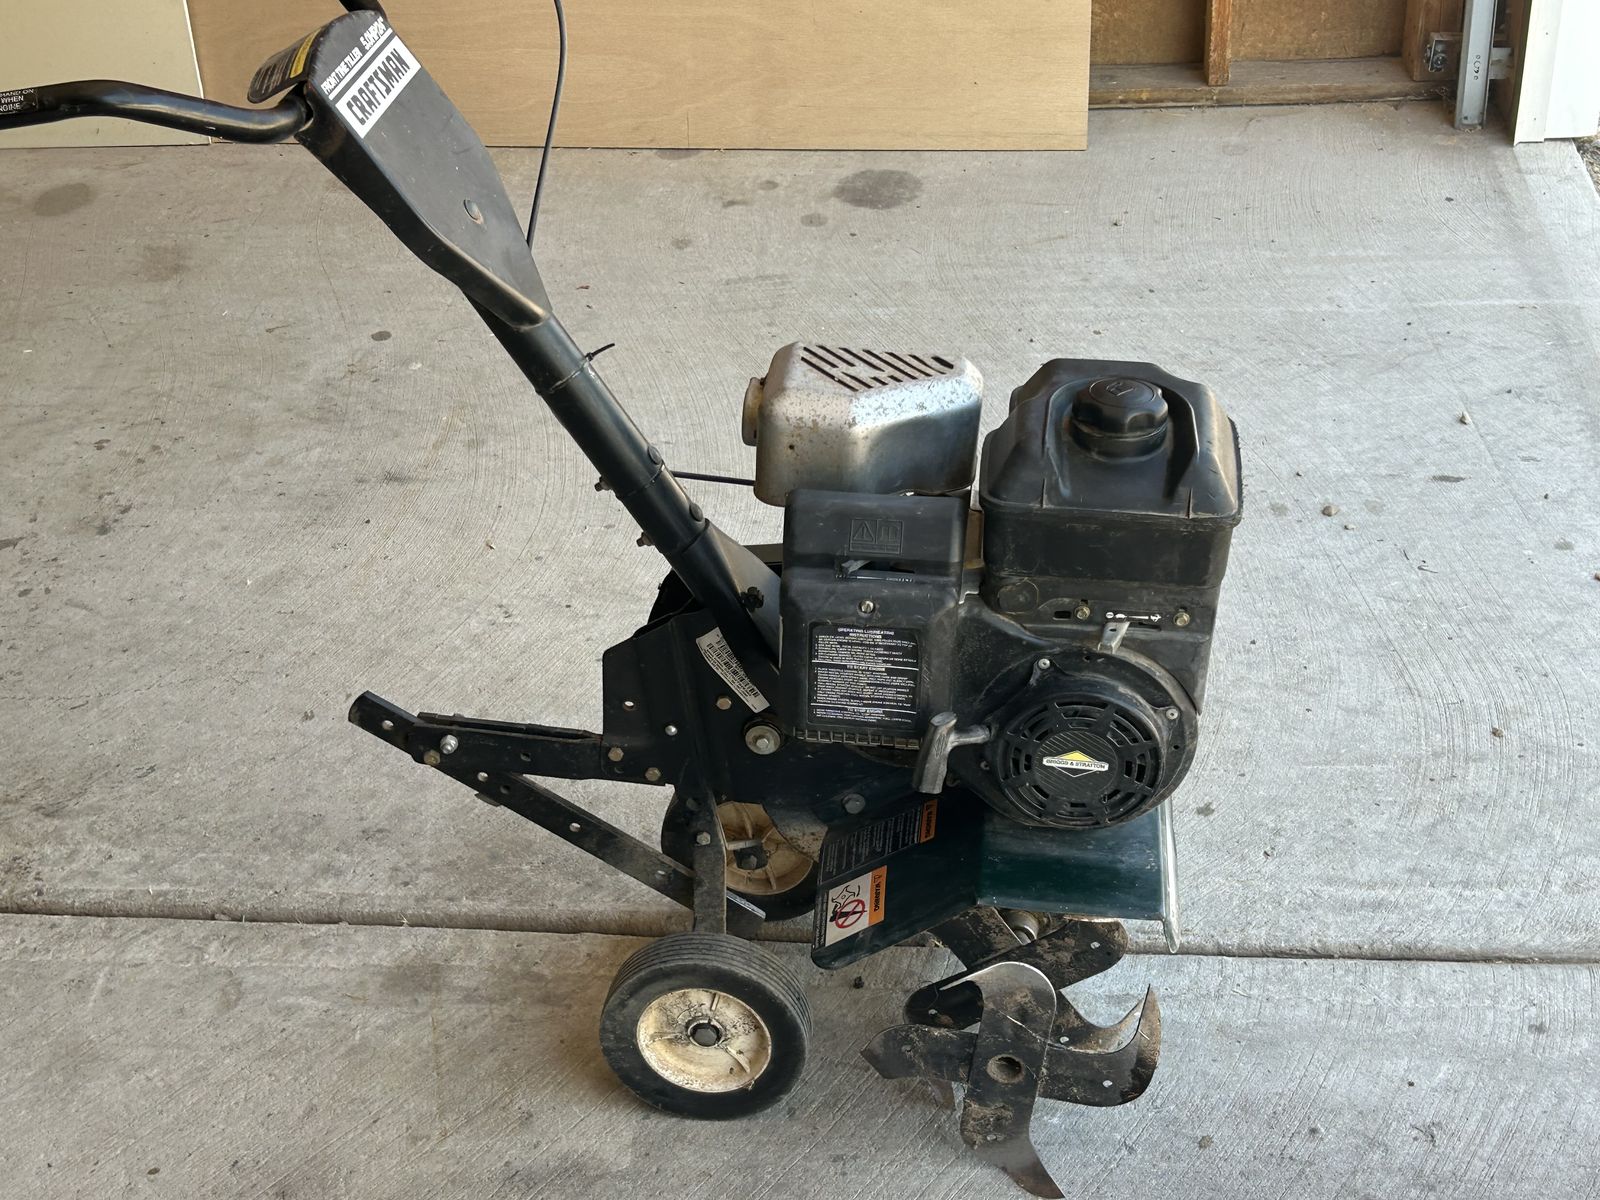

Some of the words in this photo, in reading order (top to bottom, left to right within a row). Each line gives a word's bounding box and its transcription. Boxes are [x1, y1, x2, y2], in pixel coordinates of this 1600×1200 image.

[321, 71, 341, 95] FRONT
[335, 61, 350, 79] TINE
[344, 47, 363, 69] TILLER
[1, 95, 24, 104] WHEN
[346, 48, 411, 126] CRAFTSMAN
[1075, 761, 1106, 769] STRATTON
